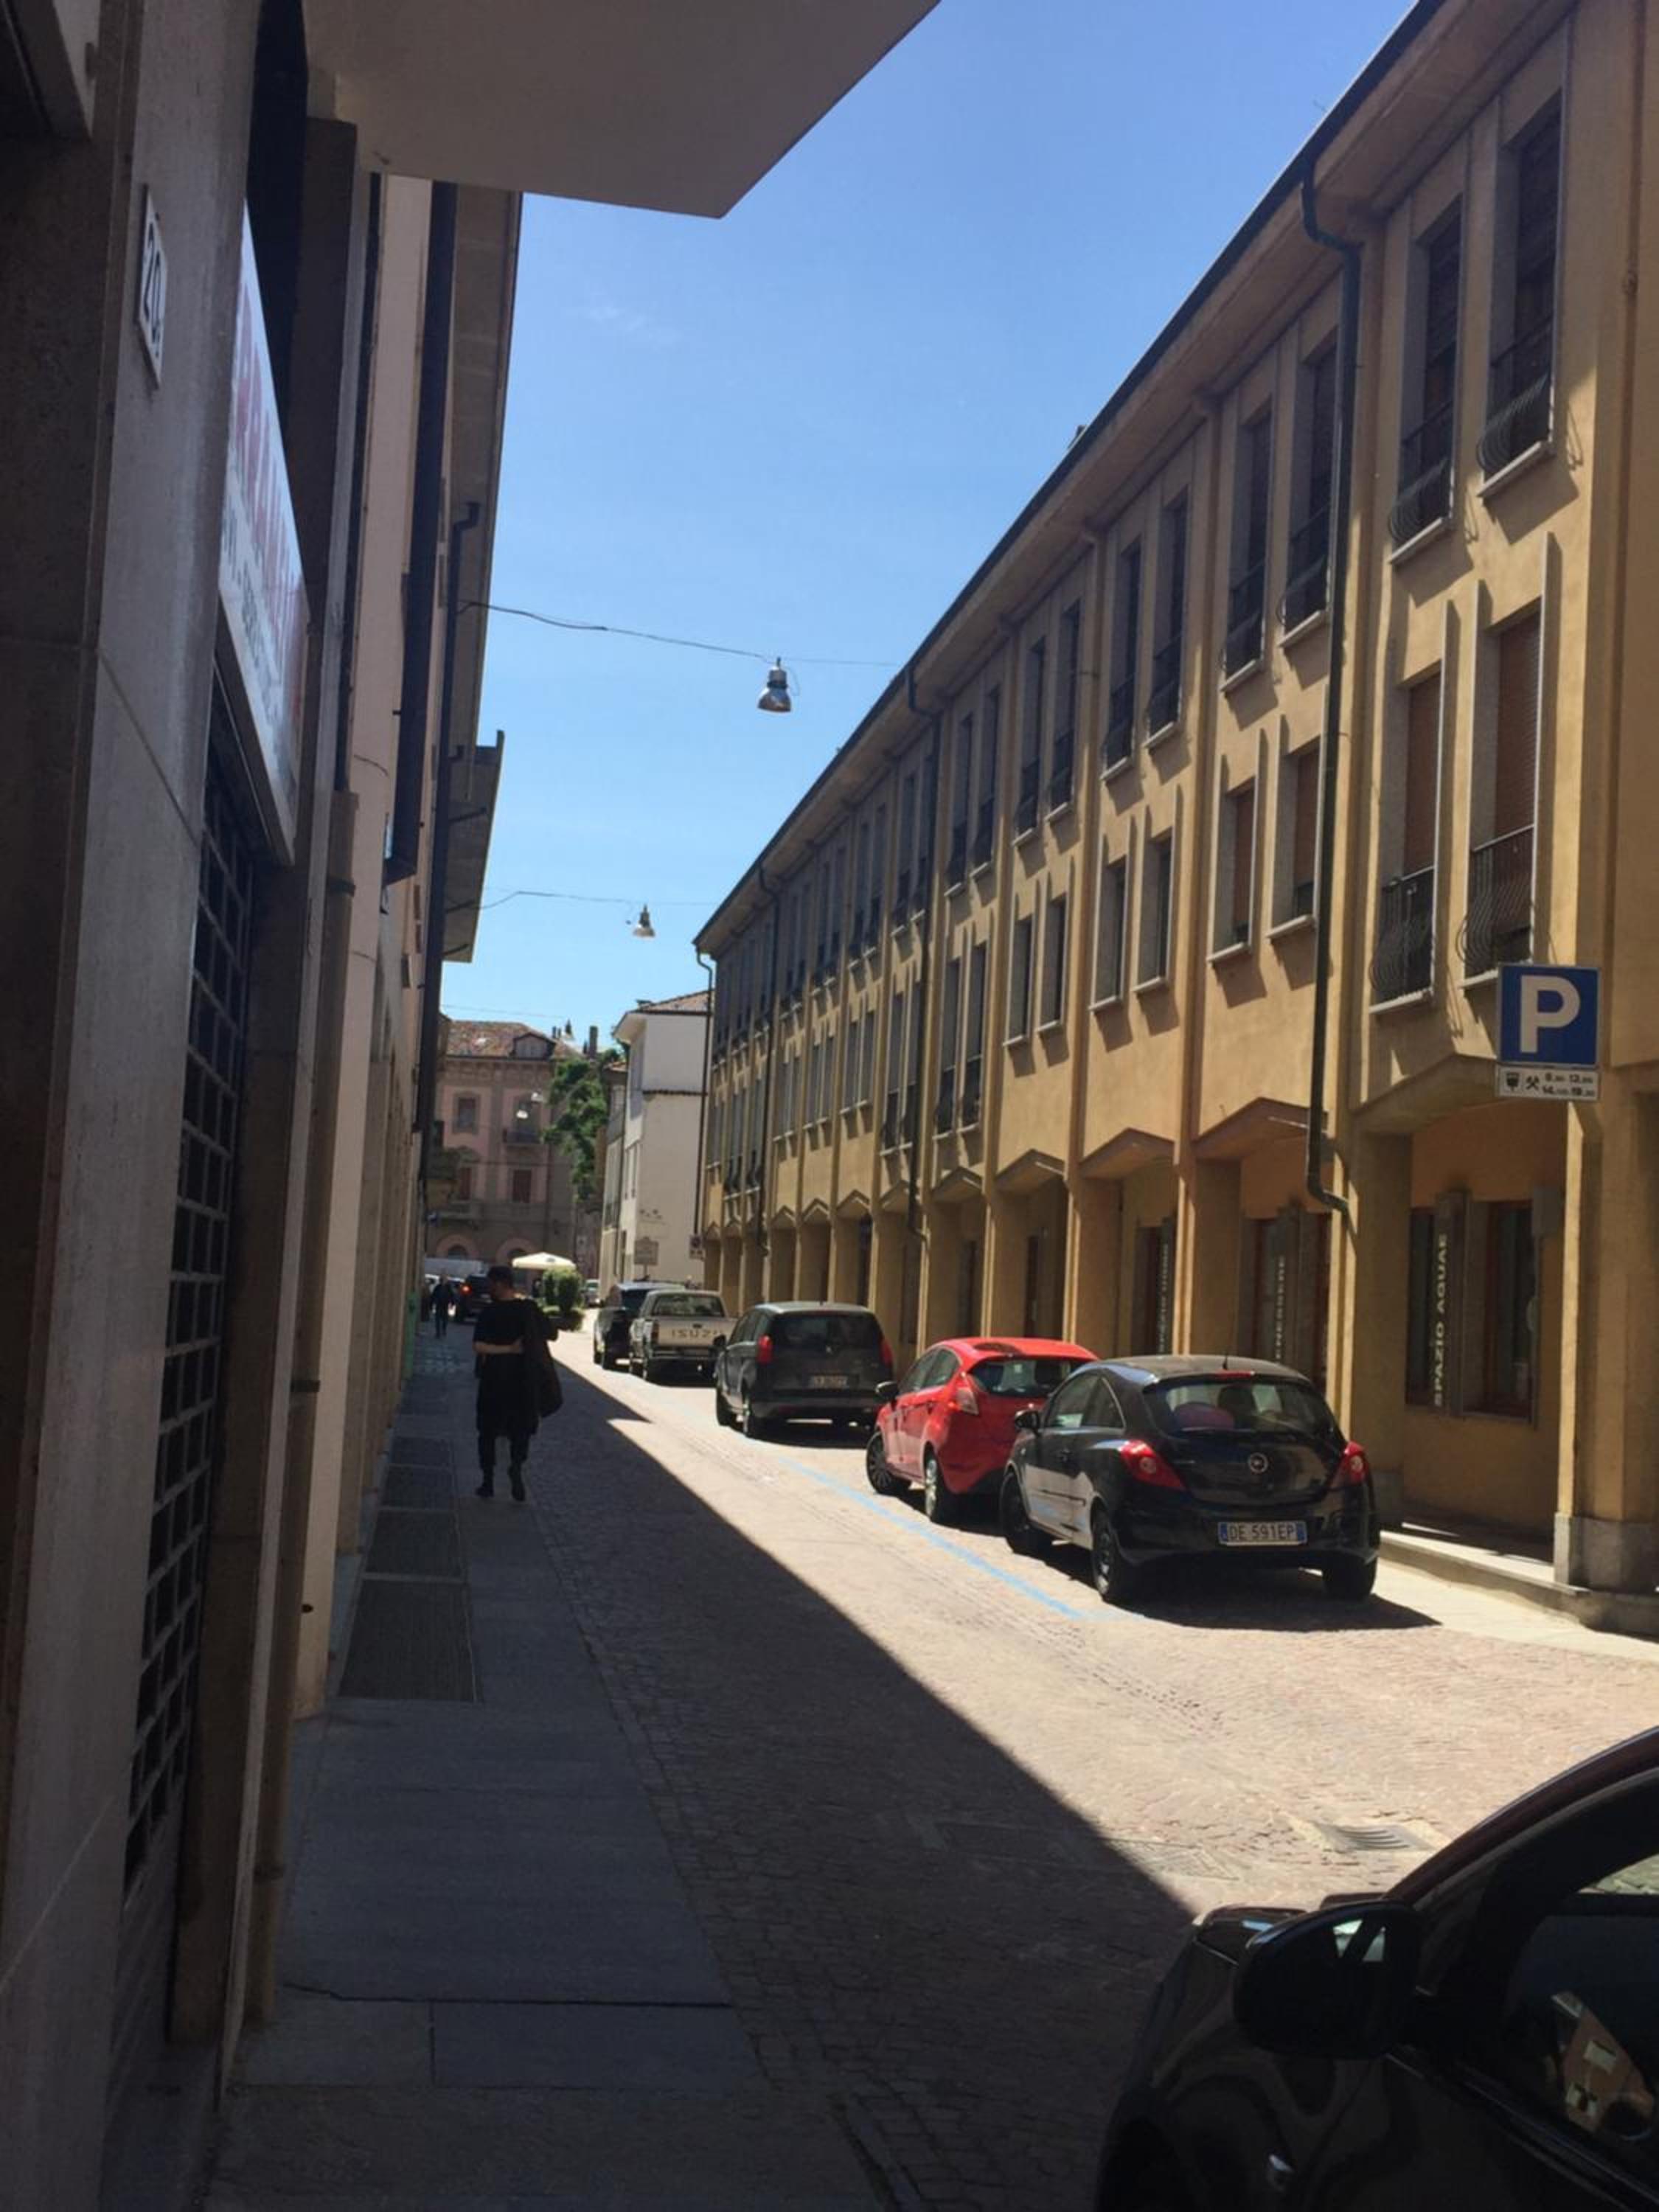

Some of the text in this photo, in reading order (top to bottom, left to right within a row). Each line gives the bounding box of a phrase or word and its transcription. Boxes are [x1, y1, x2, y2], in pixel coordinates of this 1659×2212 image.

[144, 221, 161, 345] 20
[1520, 975, 1581, 1053] P
[1276, 1256, 1285, 1360] ENESSERE
[1433, 1321, 1445, 1407] SPAZIO
[1228, 1523, 1295, 1540] DE 591EP
